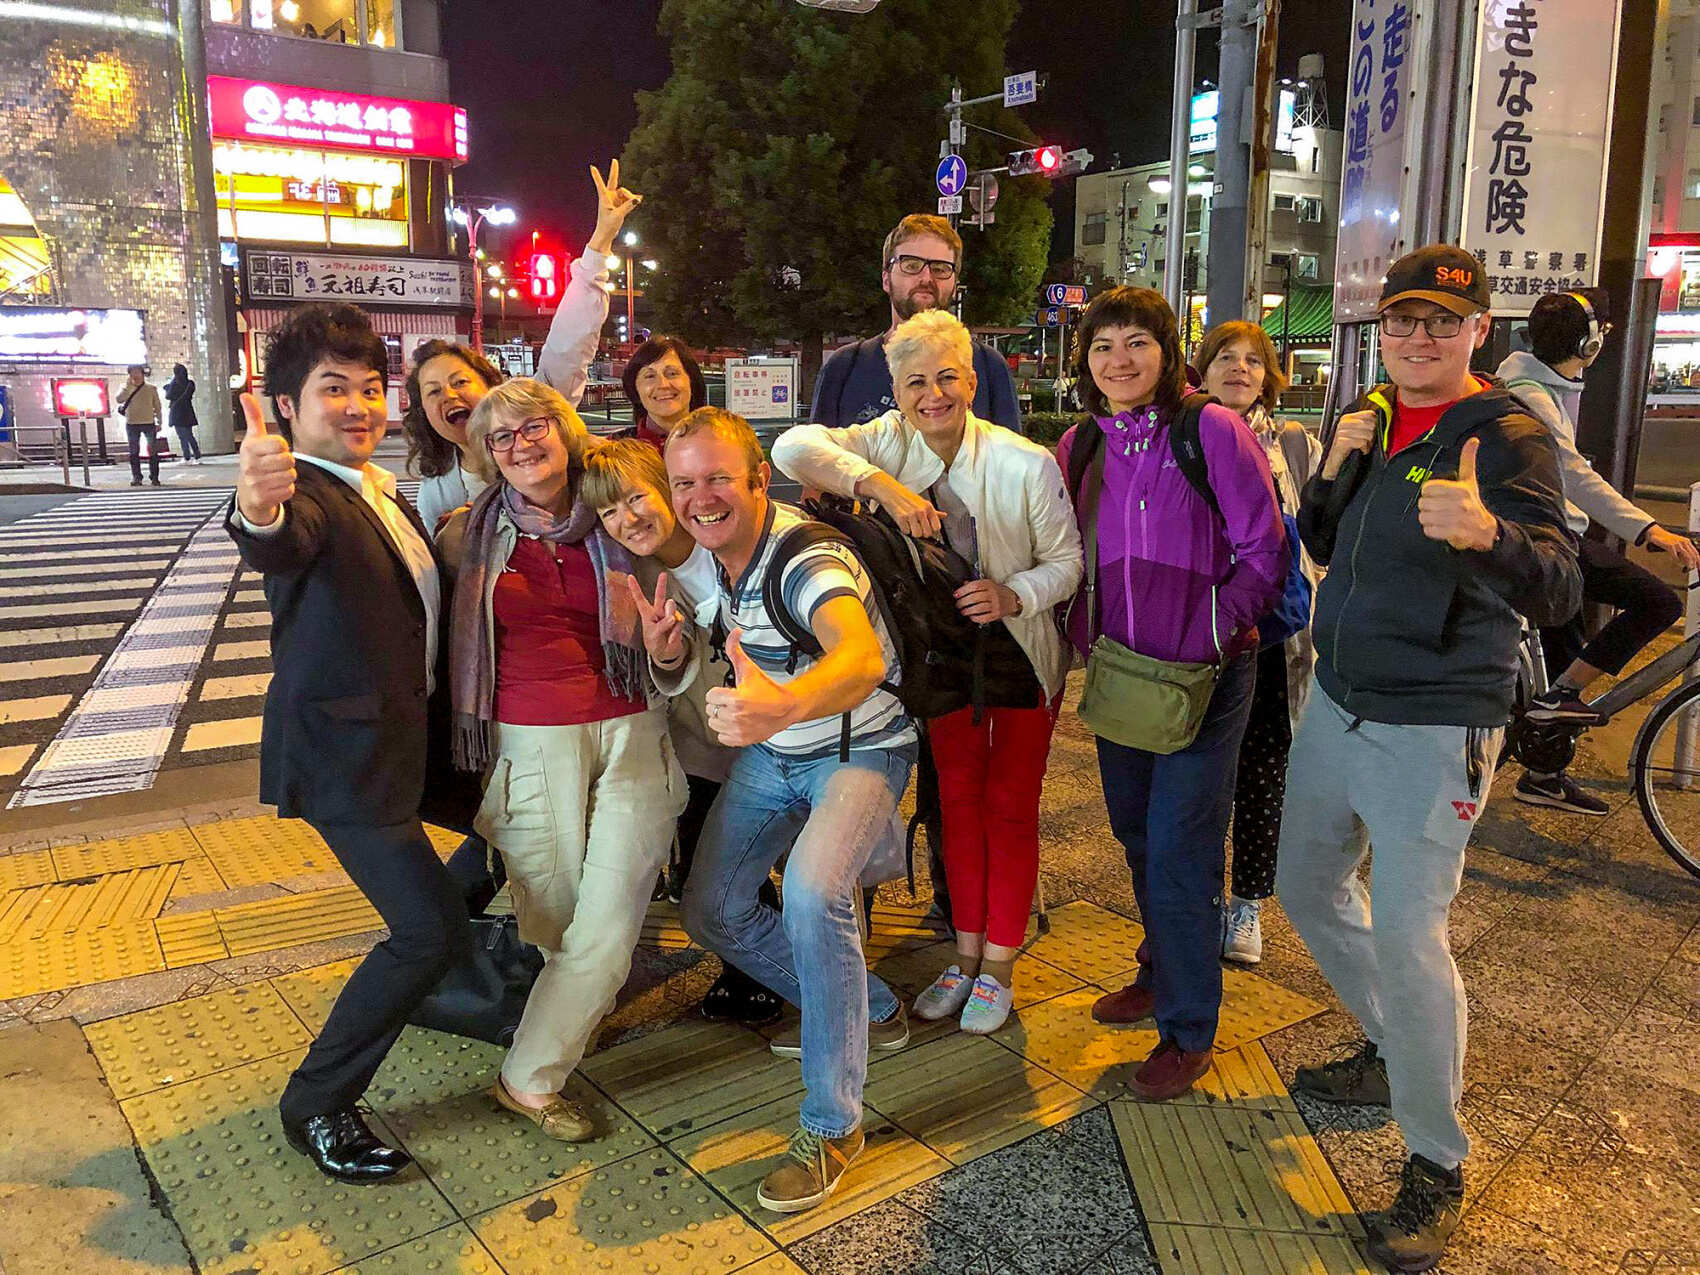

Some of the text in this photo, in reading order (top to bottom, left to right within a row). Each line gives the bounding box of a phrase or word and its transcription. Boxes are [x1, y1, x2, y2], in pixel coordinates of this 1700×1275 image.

[251, 256, 290, 274] 回転
[320, 274, 406, 296] 元祖寿司
[1435, 266, 1472, 286] S4U
[252, 277, 290, 294] 寿司
[1056, 286, 1064, 299] 6
